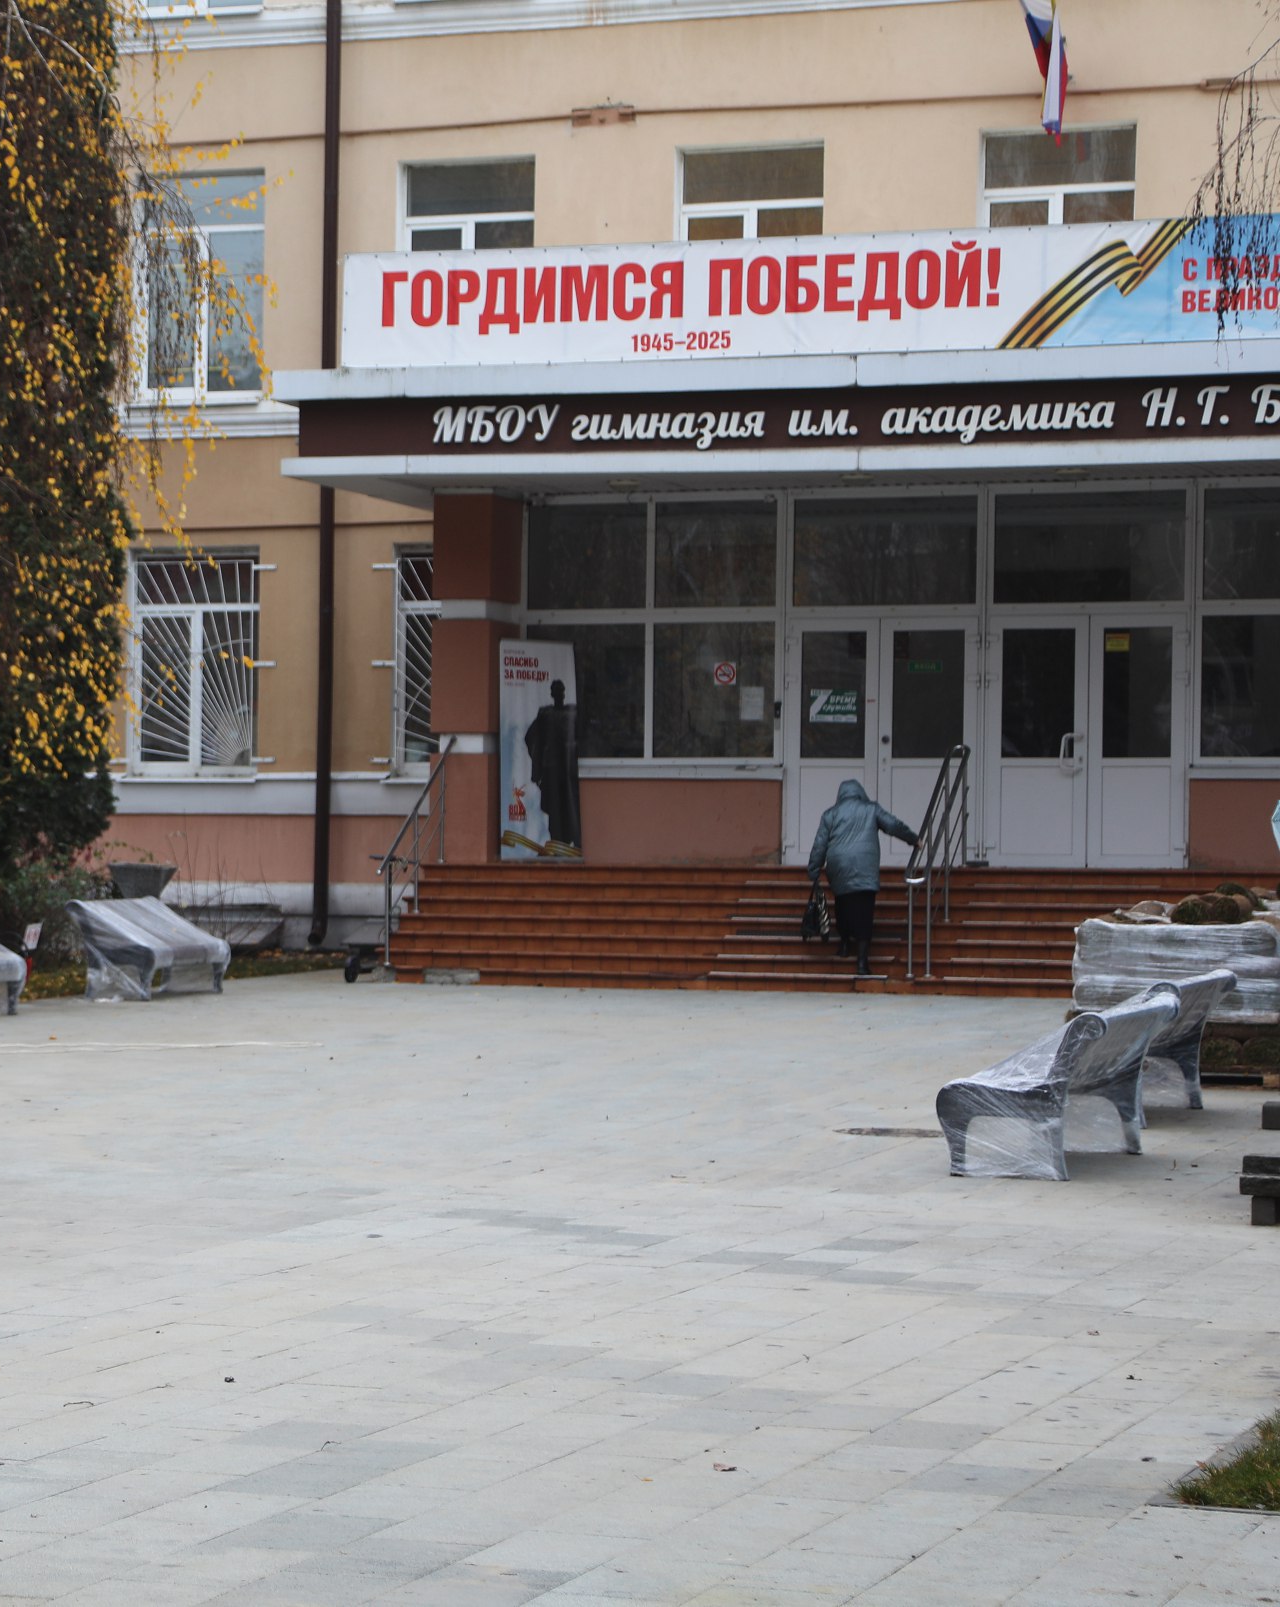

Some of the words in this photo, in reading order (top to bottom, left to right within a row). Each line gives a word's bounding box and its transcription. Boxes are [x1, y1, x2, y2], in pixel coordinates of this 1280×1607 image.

[1183, 257, 1198, 282] С
[381, 260, 684, 335] ГОРДИМСЯ
[708, 240, 1001, 321] ПОБЕДОЙ!
[433, 404, 560, 443] МБОУ
[570, 410, 766, 450] гимназия
[788, 409, 859, 437] им.
[880, 400, 1115, 444] академика
[1141, 386, 1186, 427] Н.
[504, 656, 539, 668] СПАСИБО
[504, 669, 514, 680] ЗА
[516, 670, 550, 683] ПОБЕДУ!
